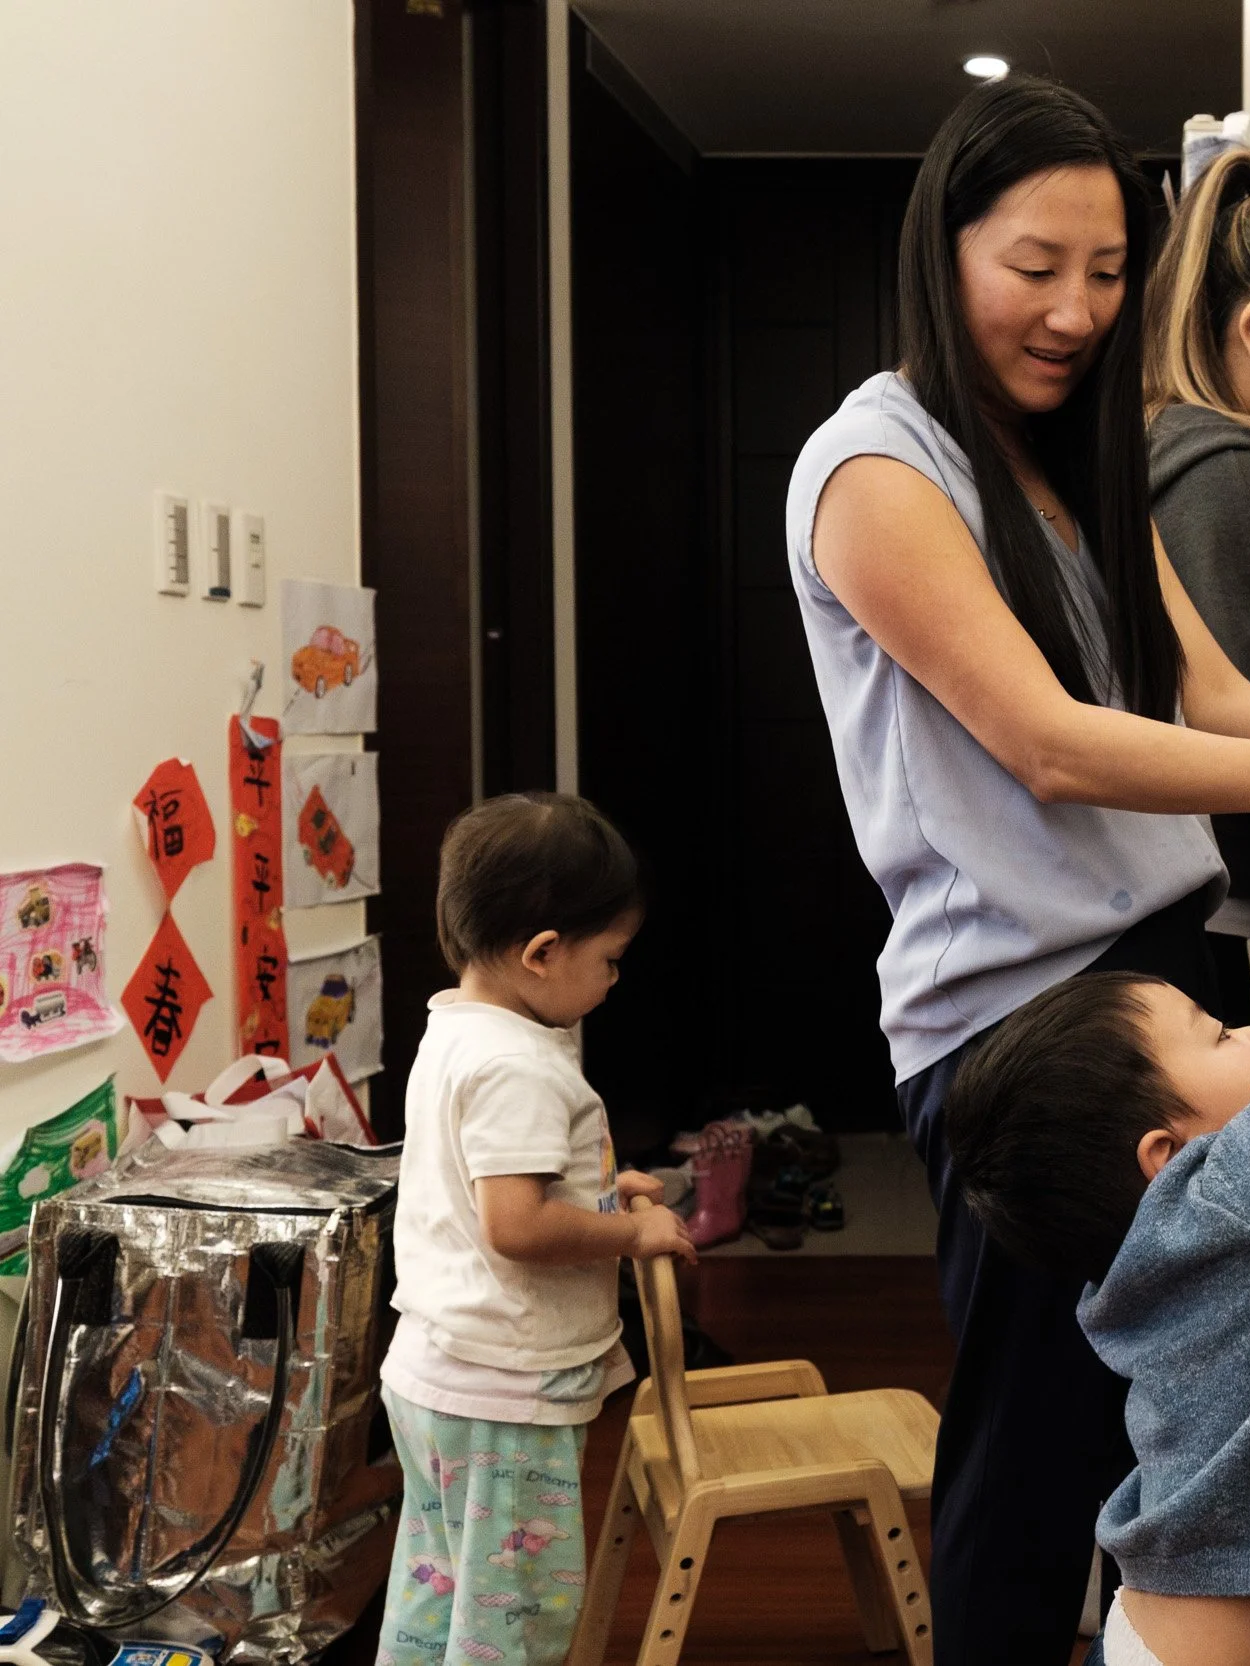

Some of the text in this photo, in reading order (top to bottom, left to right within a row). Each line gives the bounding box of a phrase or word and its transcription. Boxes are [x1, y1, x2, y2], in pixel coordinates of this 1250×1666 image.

[146, 789, 184, 862] 福
[143, 958, 183, 1057] 春
[526, 1470, 578, 1490] Dream
[396, 1630, 447, 1650] Dream
